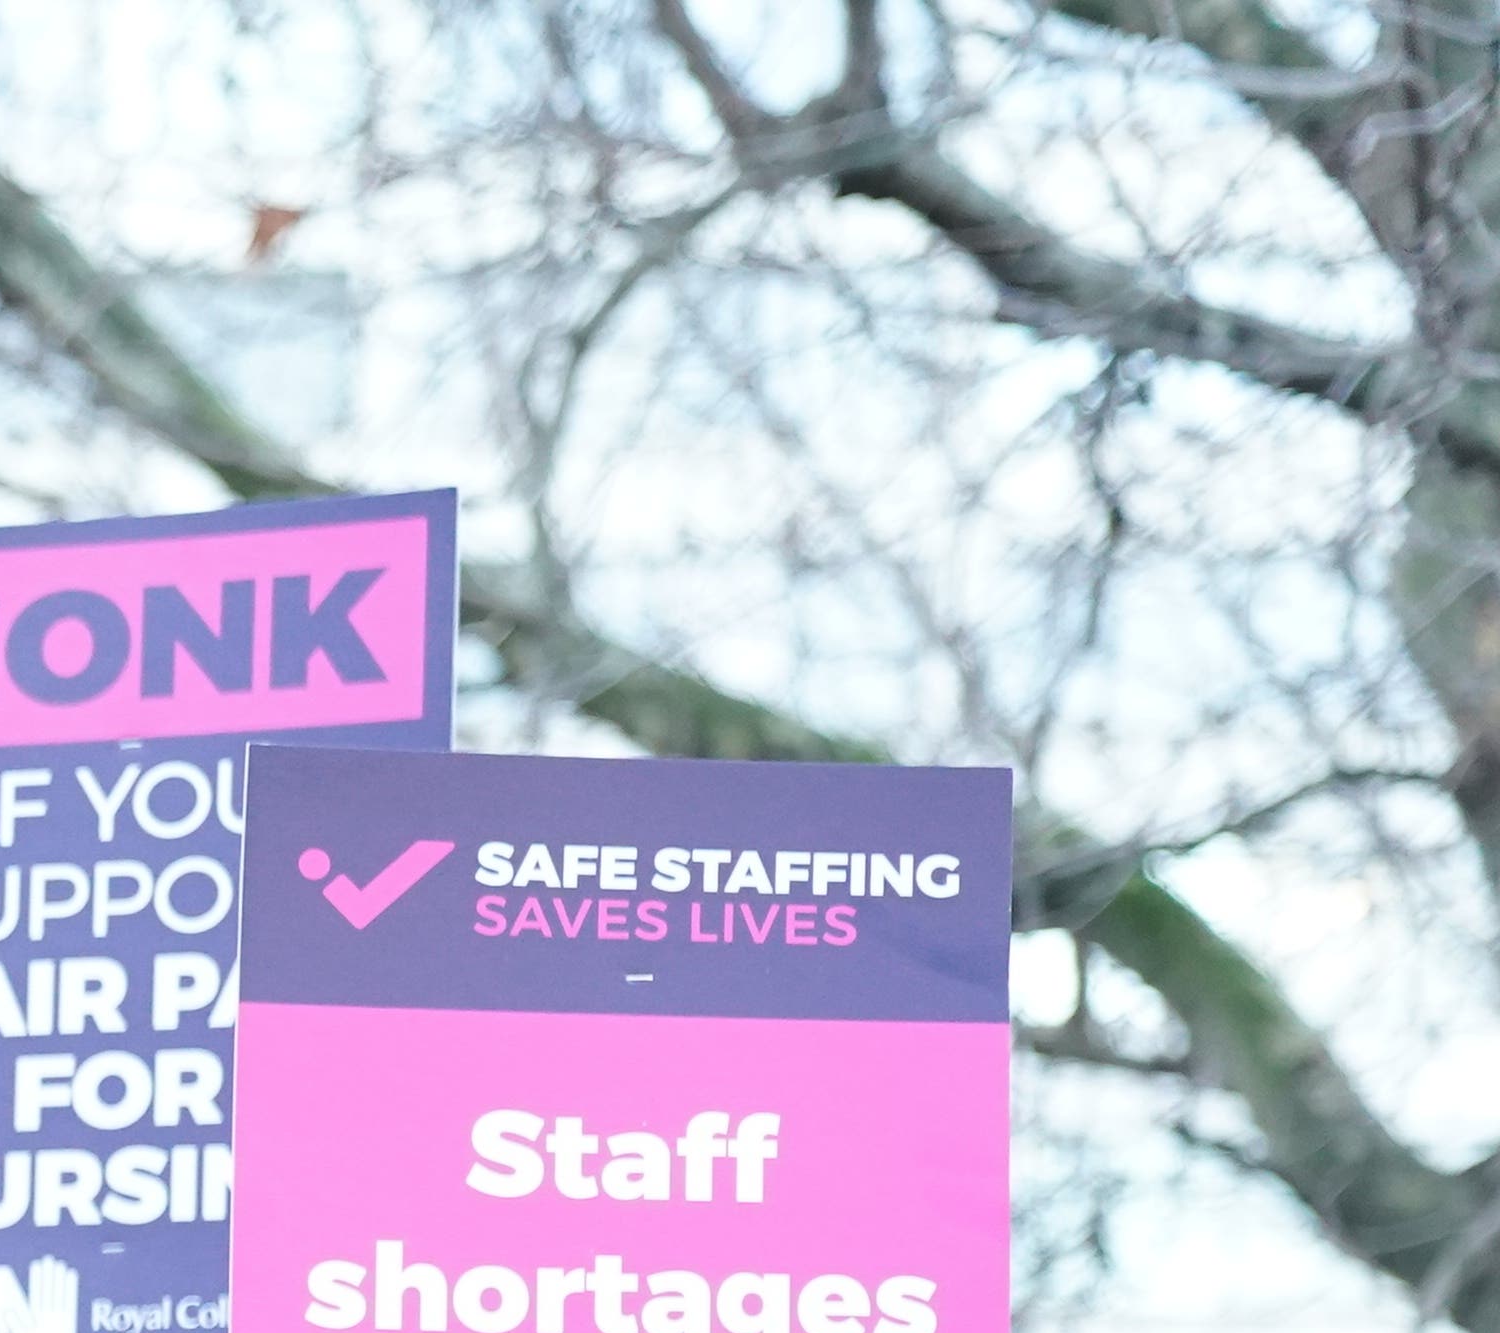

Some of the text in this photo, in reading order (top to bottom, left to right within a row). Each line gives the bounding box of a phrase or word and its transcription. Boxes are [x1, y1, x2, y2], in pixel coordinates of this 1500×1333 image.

[474, 842, 960, 900] SAFE STAFFING
[473, 894, 859, 948] SAVES LIVES
[12, 1047, 224, 1133] FOR
[465, 1107, 782, 1205] Staff
